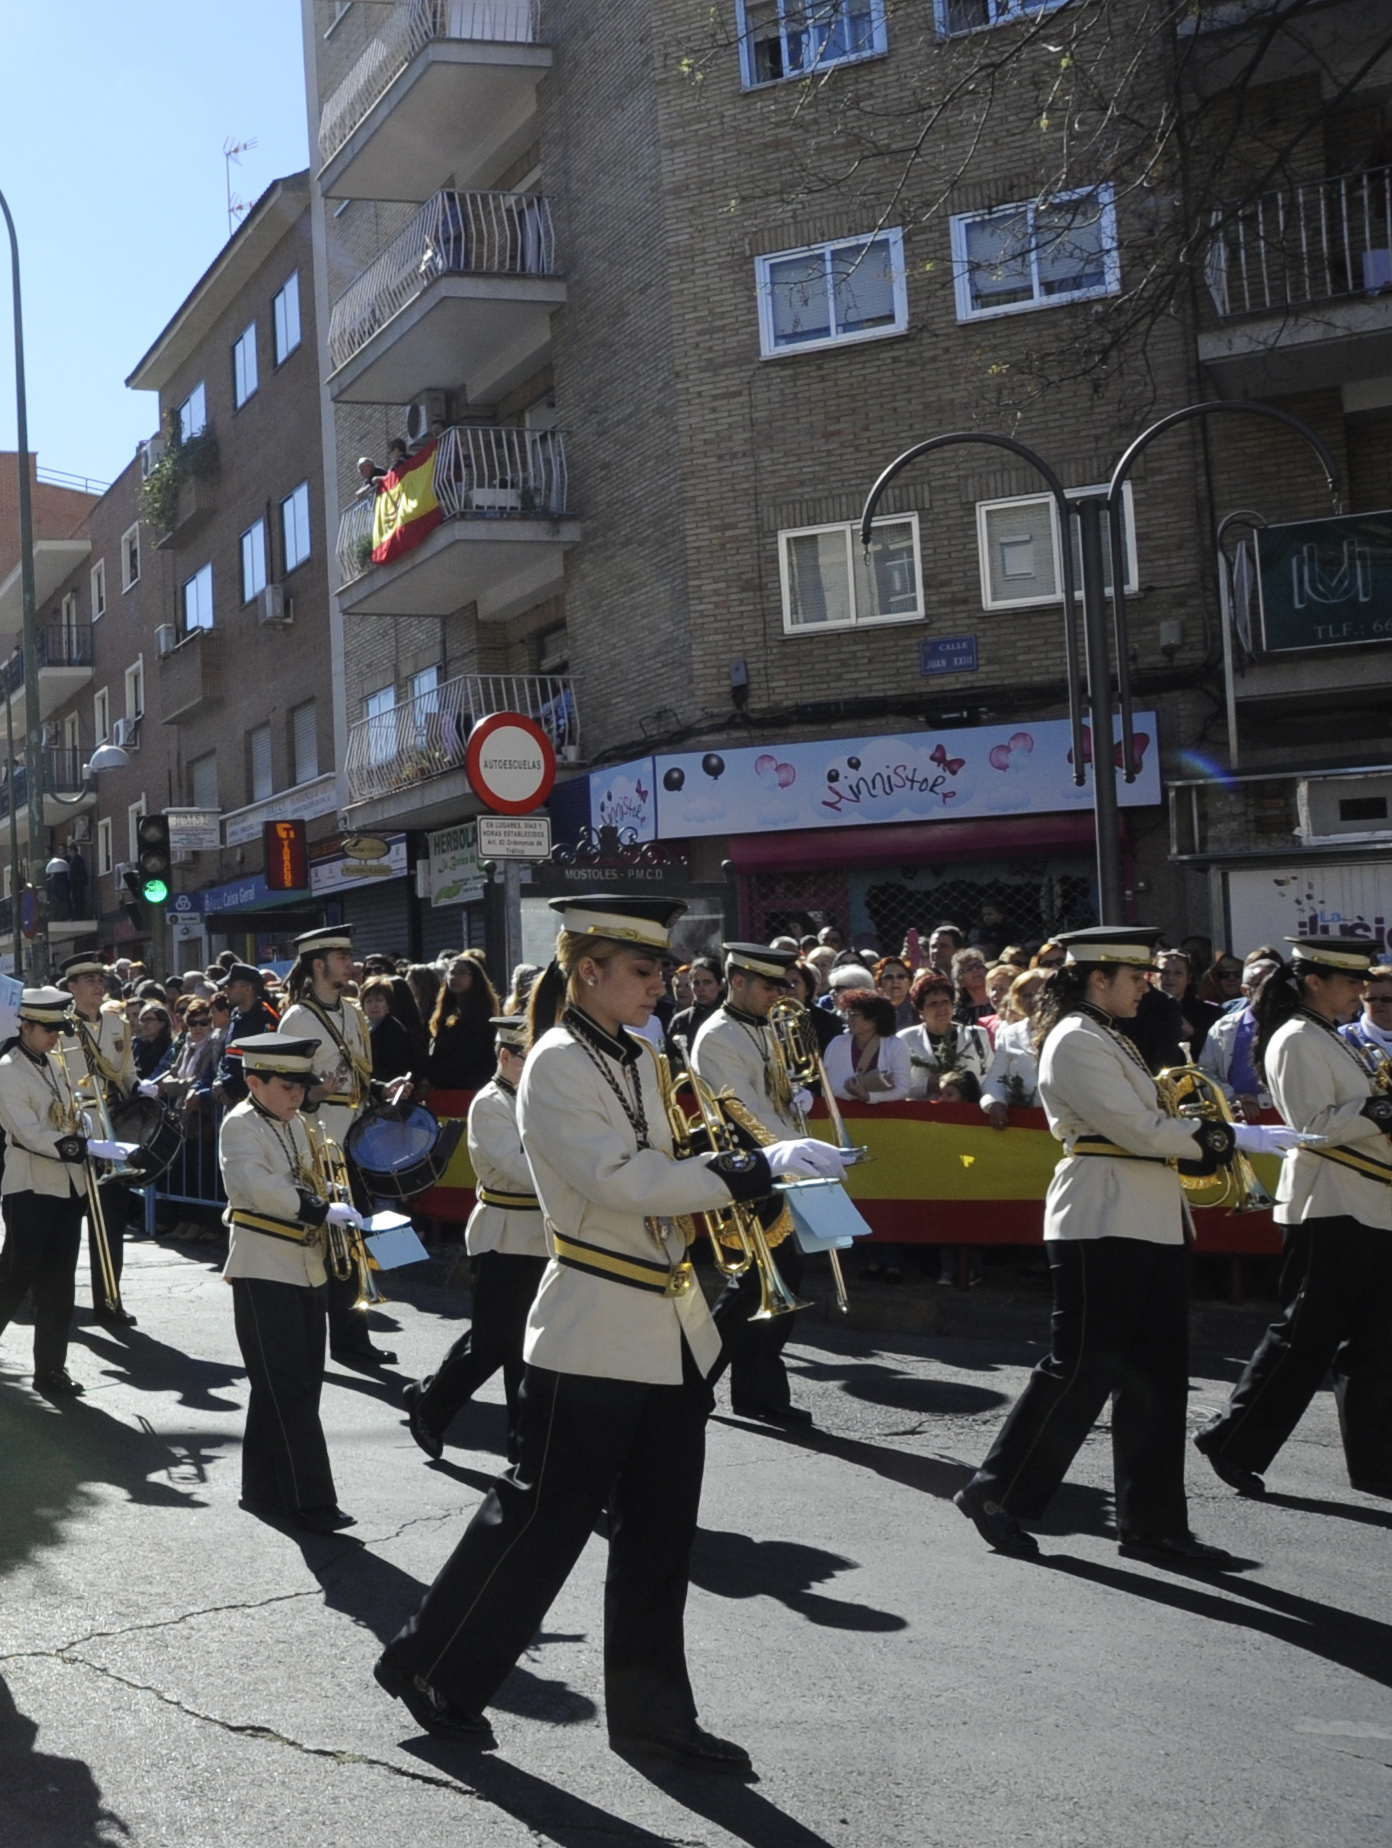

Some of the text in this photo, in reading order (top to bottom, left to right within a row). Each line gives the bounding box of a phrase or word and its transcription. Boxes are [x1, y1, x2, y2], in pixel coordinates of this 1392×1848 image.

[939, 641, 968, 652] CALLE
[483, 759, 542, 770] AUTOESCUELAS
[485, 821, 494, 829] EN
[483, 830, 502, 838] HORAS
[1319, 909, 1342, 923] La
